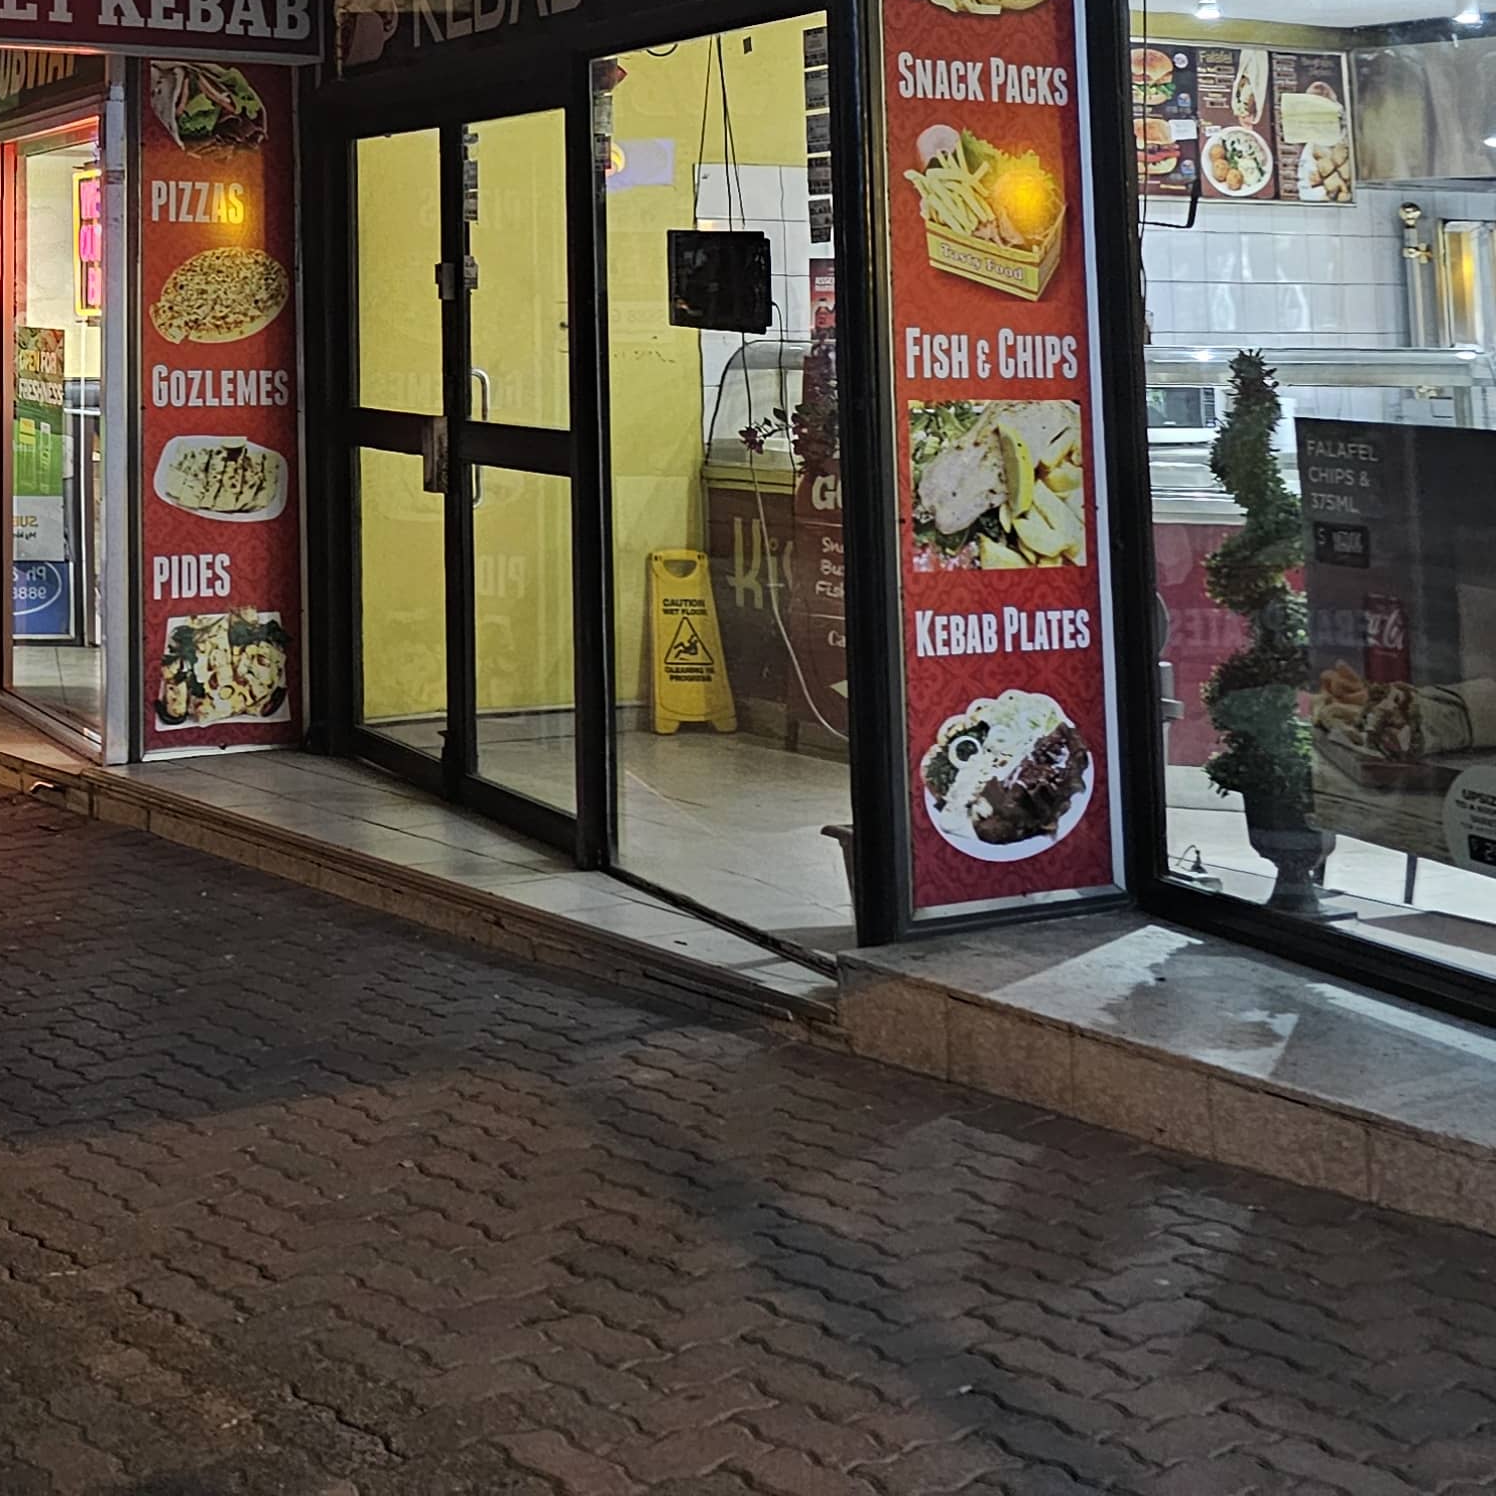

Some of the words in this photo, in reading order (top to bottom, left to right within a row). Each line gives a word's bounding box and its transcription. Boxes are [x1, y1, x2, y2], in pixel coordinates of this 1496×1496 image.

[898, 51, 984, 102] SNACK
[990, 55, 1069, 106] PACKS
[151, 179, 245, 225] PIZZAS
[986, 258, 1024, 281] Food
[904, 326, 970, 381] FISH
[976, 338, 992, 380] &
[997, 327, 1078, 380] CHIPS
[151, 363, 289, 407] GOZLEMES
[1306, 440, 1380, 462] FALAFEL
[1307, 466, 1355, 486] CHIPS
[152, 553, 232, 600] PIDES
[915, 609, 999, 659] KEBAB
[1003, 605, 1091, 653] PLATES
